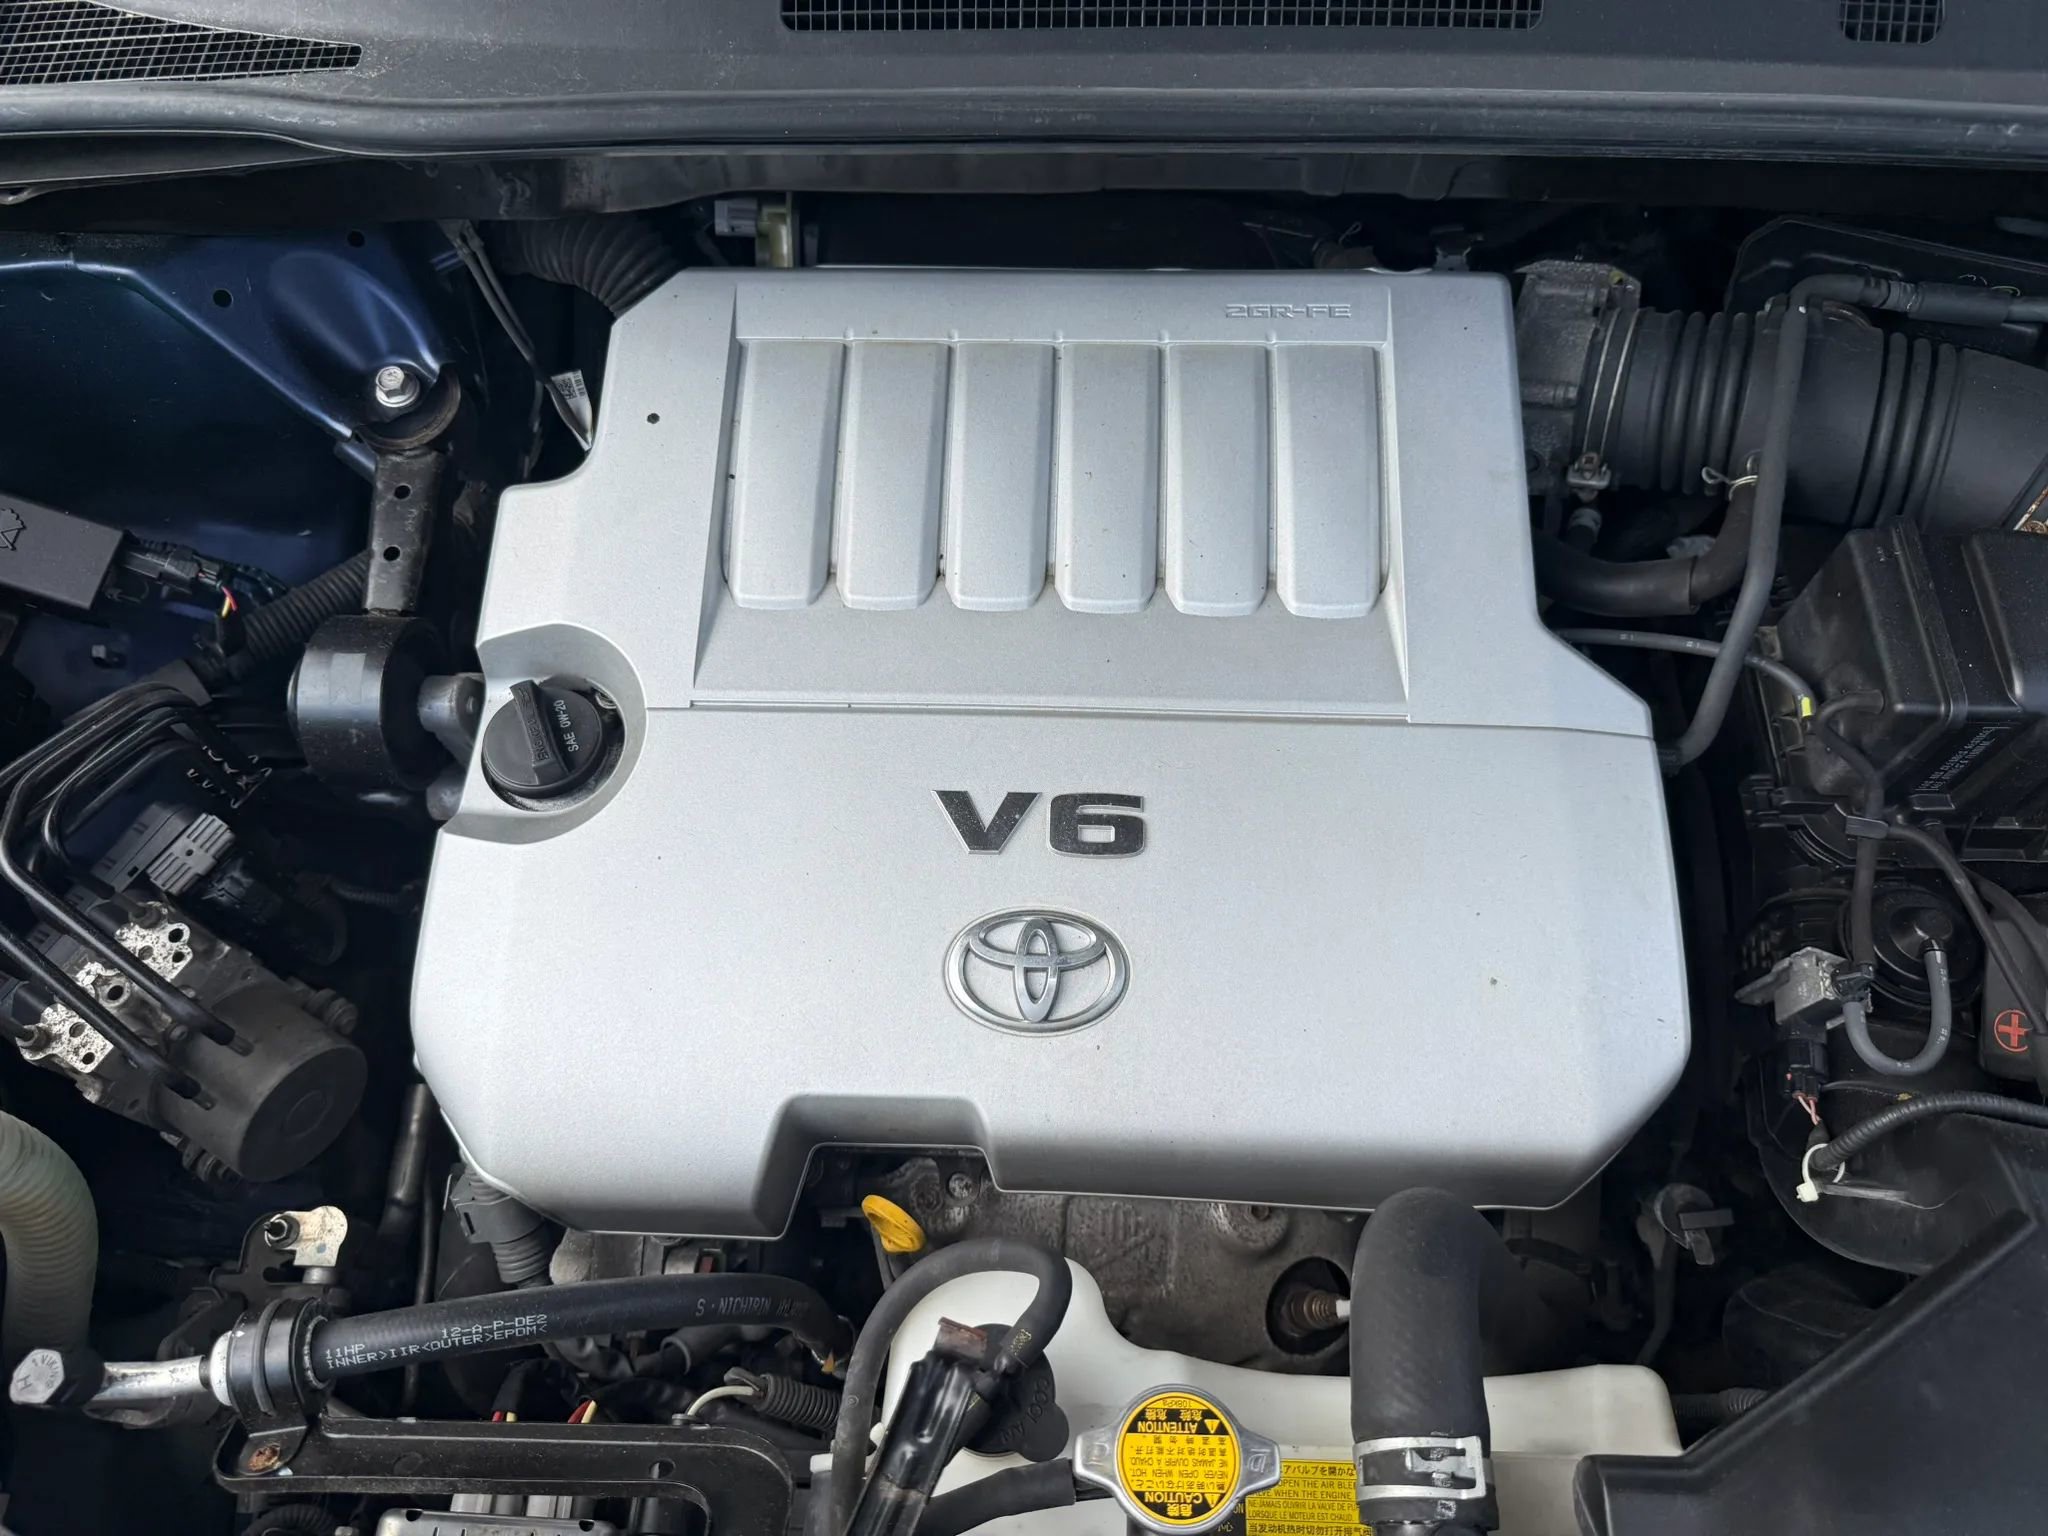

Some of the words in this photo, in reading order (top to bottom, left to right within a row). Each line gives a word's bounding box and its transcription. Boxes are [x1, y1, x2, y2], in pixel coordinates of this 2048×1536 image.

[1226, 303, 1352, 318] 2GR-FE
[553, 699, 572, 728] 0W-20
[563, 732, 580, 752] SAE
[931, 789, 1145, 858] V6
[325, 1343, 366, 1359] 11HP
[440, 1314, 548, 1339] 12-A-P-DE2
[1162, 1399, 1193, 1409] 108kPa
[1137, 1420, 1198, 1433] ATTENTION
[1165, 1457, 1190, 1467] OUVRIR
[1191, 1458, 1217, 1467] JAMAIS
[1218, 1459, 1228, 1468] NE
[1152, 1468, 1174, 1478] WHEN
[1178, 1469, 1199, 1479] OPEN
[1203, 1470, 1228, 1479] NEVER
[1303, 1480, 1320, 1488] THE
[1320, 1481, 1335, 1489] AIR
[1144, 1491, 1203, 1504] CAUTION
[1273, 1490, 1299, 1498] WHEN
[1302, 1490, 1318, 1498] THE
[1320, 1491, 1352, 1500] ENGINE
[1317, 1502, 1336, 1511] VALVE
[1336, 1503, 1345, 1511] DE
[1248, 1510, 1279, 1519] LORSQUE
[1279, 1511, 1287, 1519] LE
[1288, 1511, 1316, 1520] MOTEUR
[1317, 1512, 1329, 1520] EST
